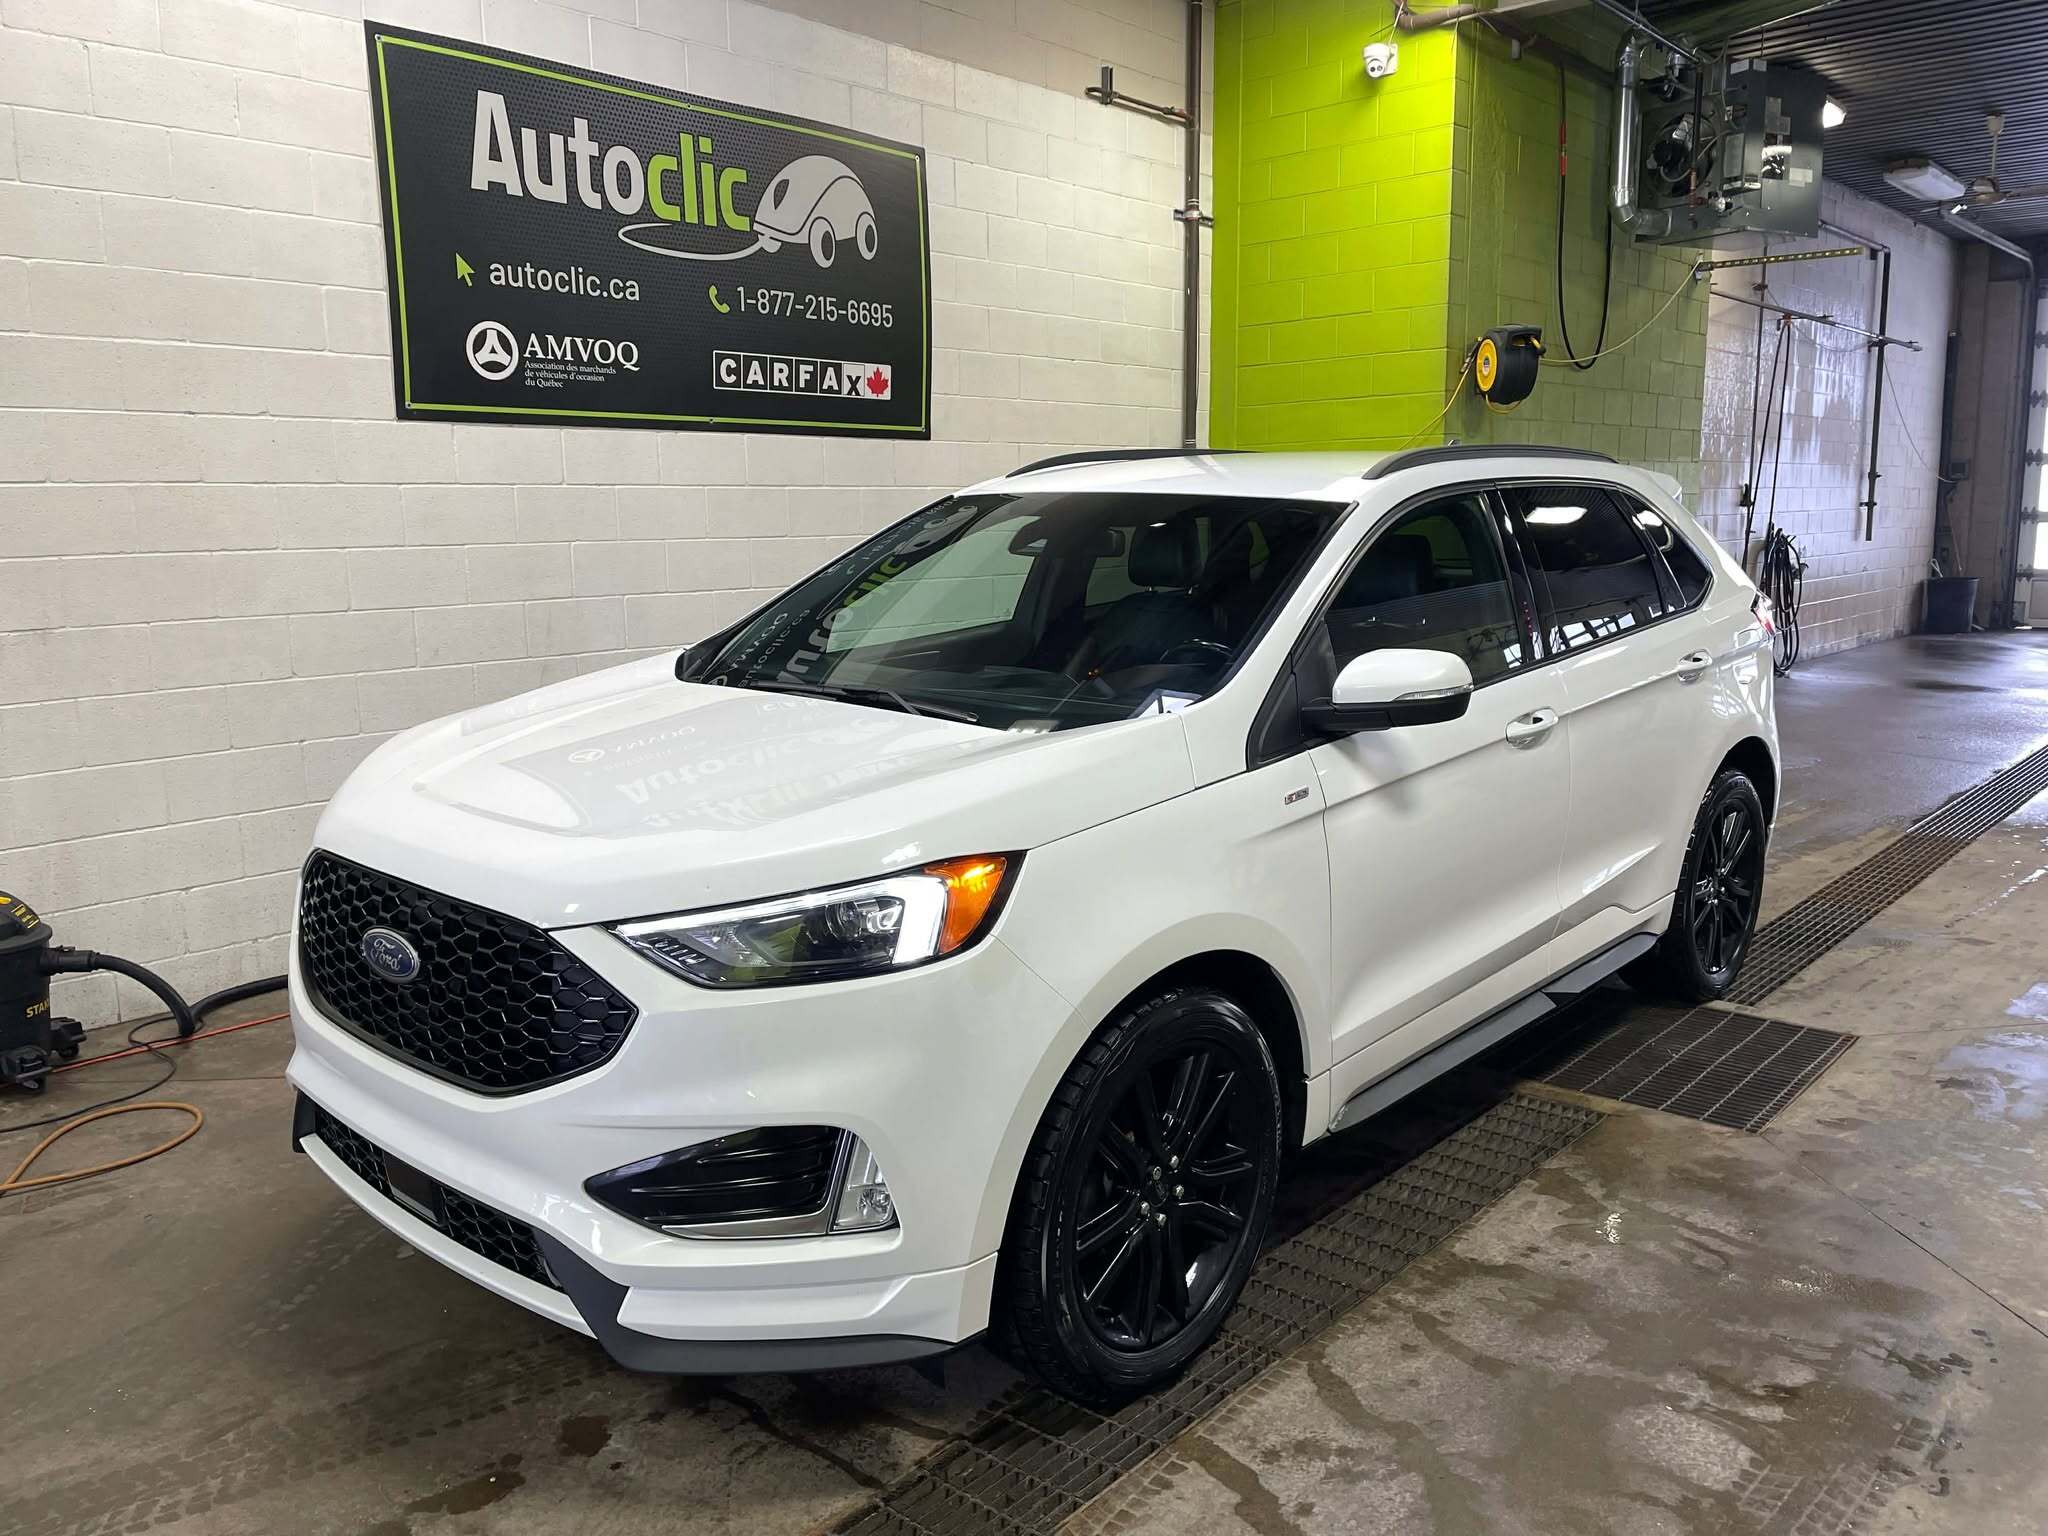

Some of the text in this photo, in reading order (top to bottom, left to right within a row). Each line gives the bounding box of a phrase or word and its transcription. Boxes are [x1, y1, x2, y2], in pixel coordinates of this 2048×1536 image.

[471, 89, 751, 232] Autoclic
[489, 262, 640, 302] autoclic.ca
[737, 286, 893, 329] 1-877-215-6695
[523, 332, 641, 372] AMVOQ
[524, 360, 617, 375] Association des marchands
[524, 370, 605, 383] de véhicules d'occasion
[525, 378, 564, 390] du Québec
[719, 358, 863, 396] CARFAX
[370, 938, 403, 971] Ford
